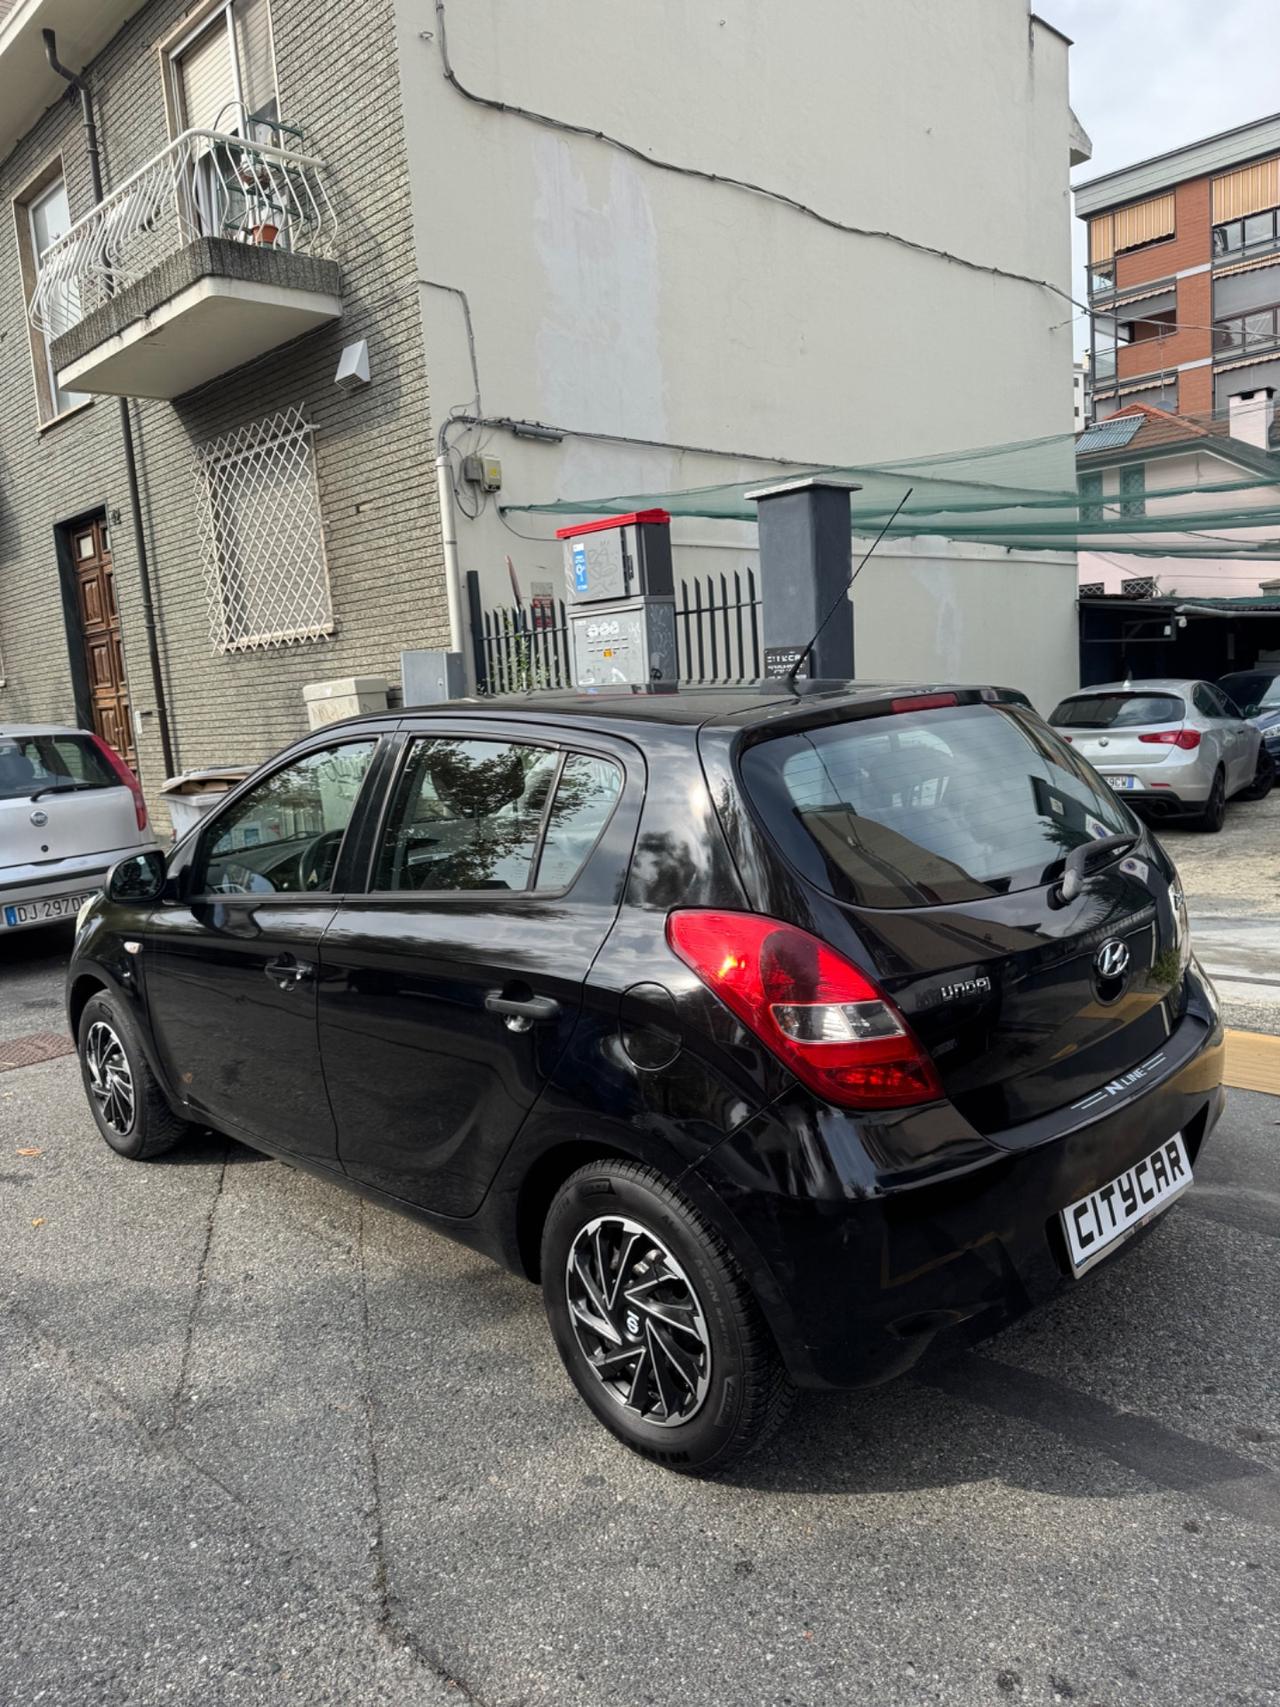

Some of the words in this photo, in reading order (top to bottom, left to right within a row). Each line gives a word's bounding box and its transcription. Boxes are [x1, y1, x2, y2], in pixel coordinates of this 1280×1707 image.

[18, 905, 38, 922] DJ
[1104, 1080, 1125, 1096] N
[1120, 1067, 1148, 1086] LINE
[1073, 1140, 1185, 1249] CITYCAR
